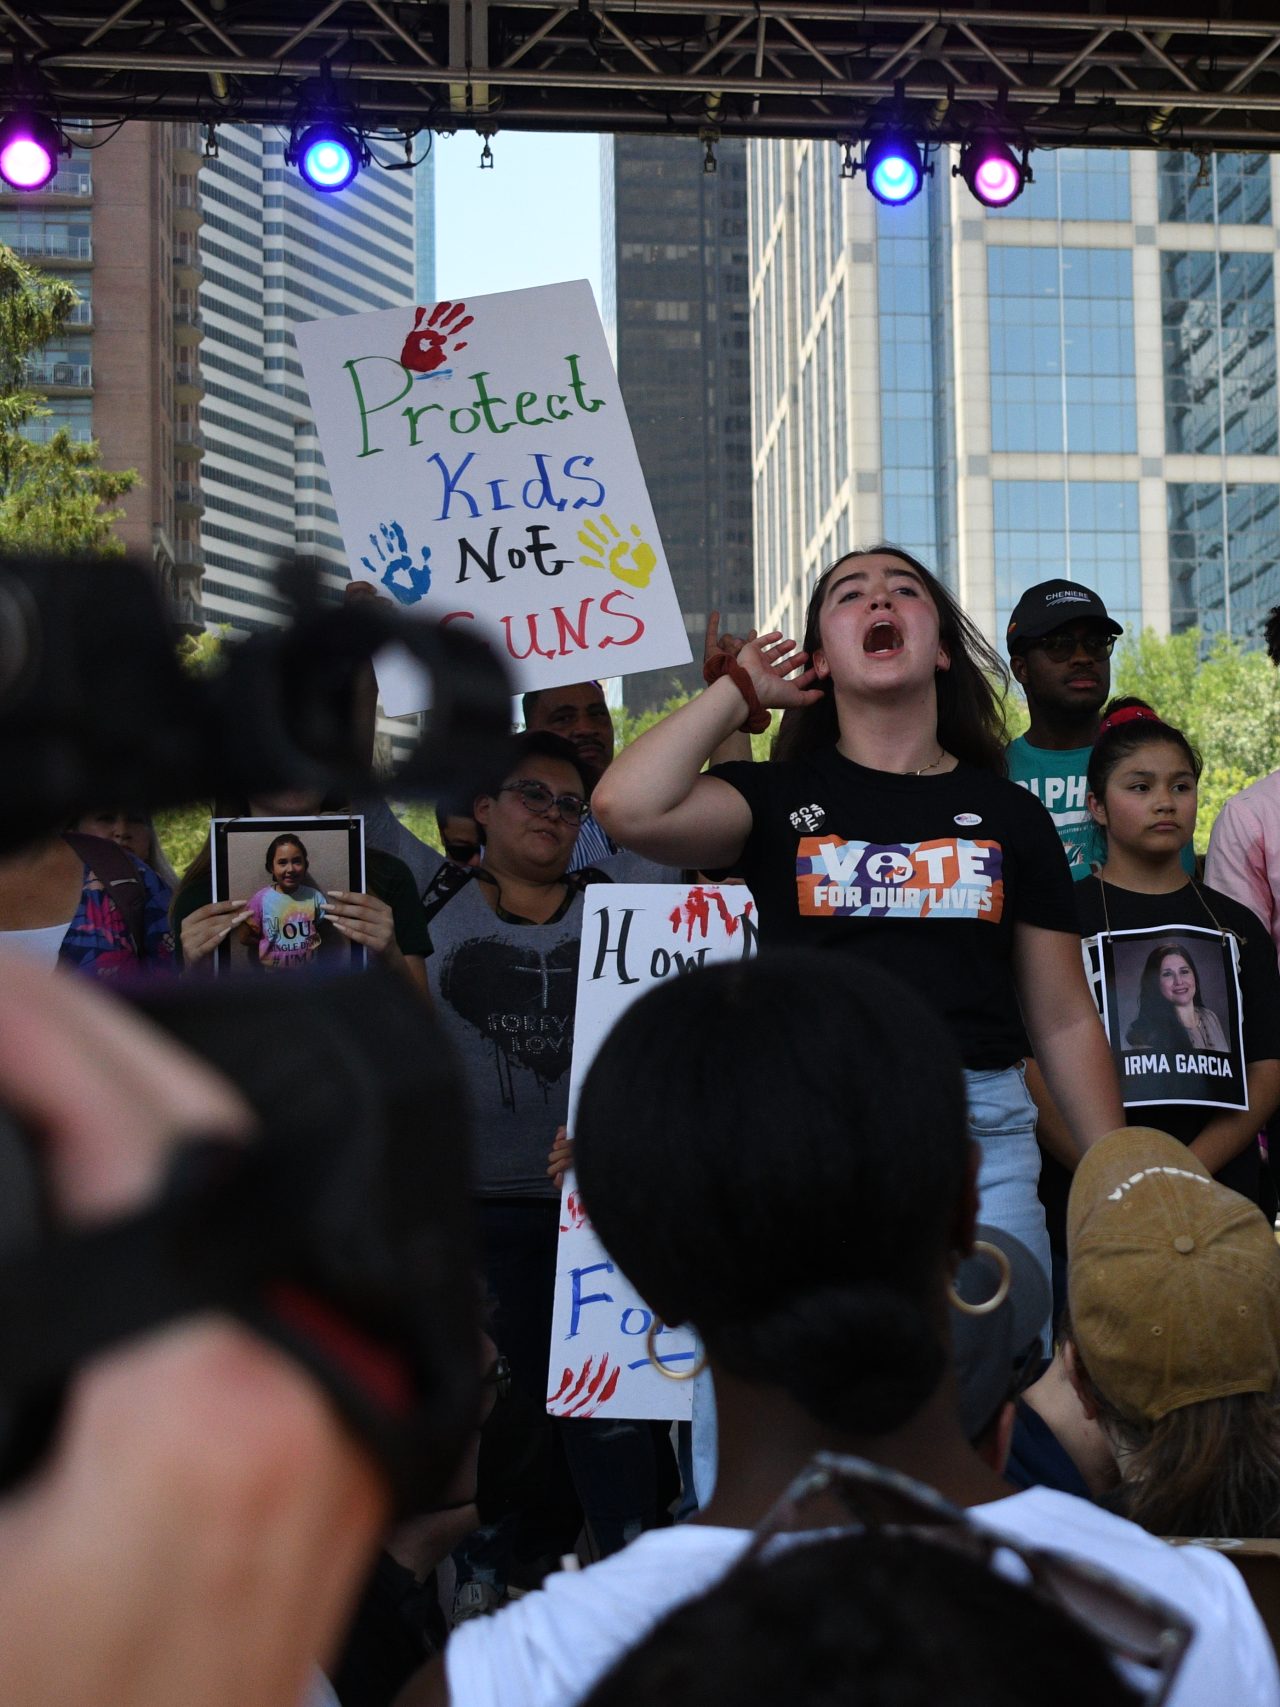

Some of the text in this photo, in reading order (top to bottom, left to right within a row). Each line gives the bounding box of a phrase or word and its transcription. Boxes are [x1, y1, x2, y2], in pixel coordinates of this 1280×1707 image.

[342, 354, 606, 458] Protect
[455, 524, 576, 584] Not
[799, 807, 820, 832] CALL
[813, 886, 993, 912] FOR OUR LIVES
[1124, 1053, 1233, 1078] IRMA GARCIA
